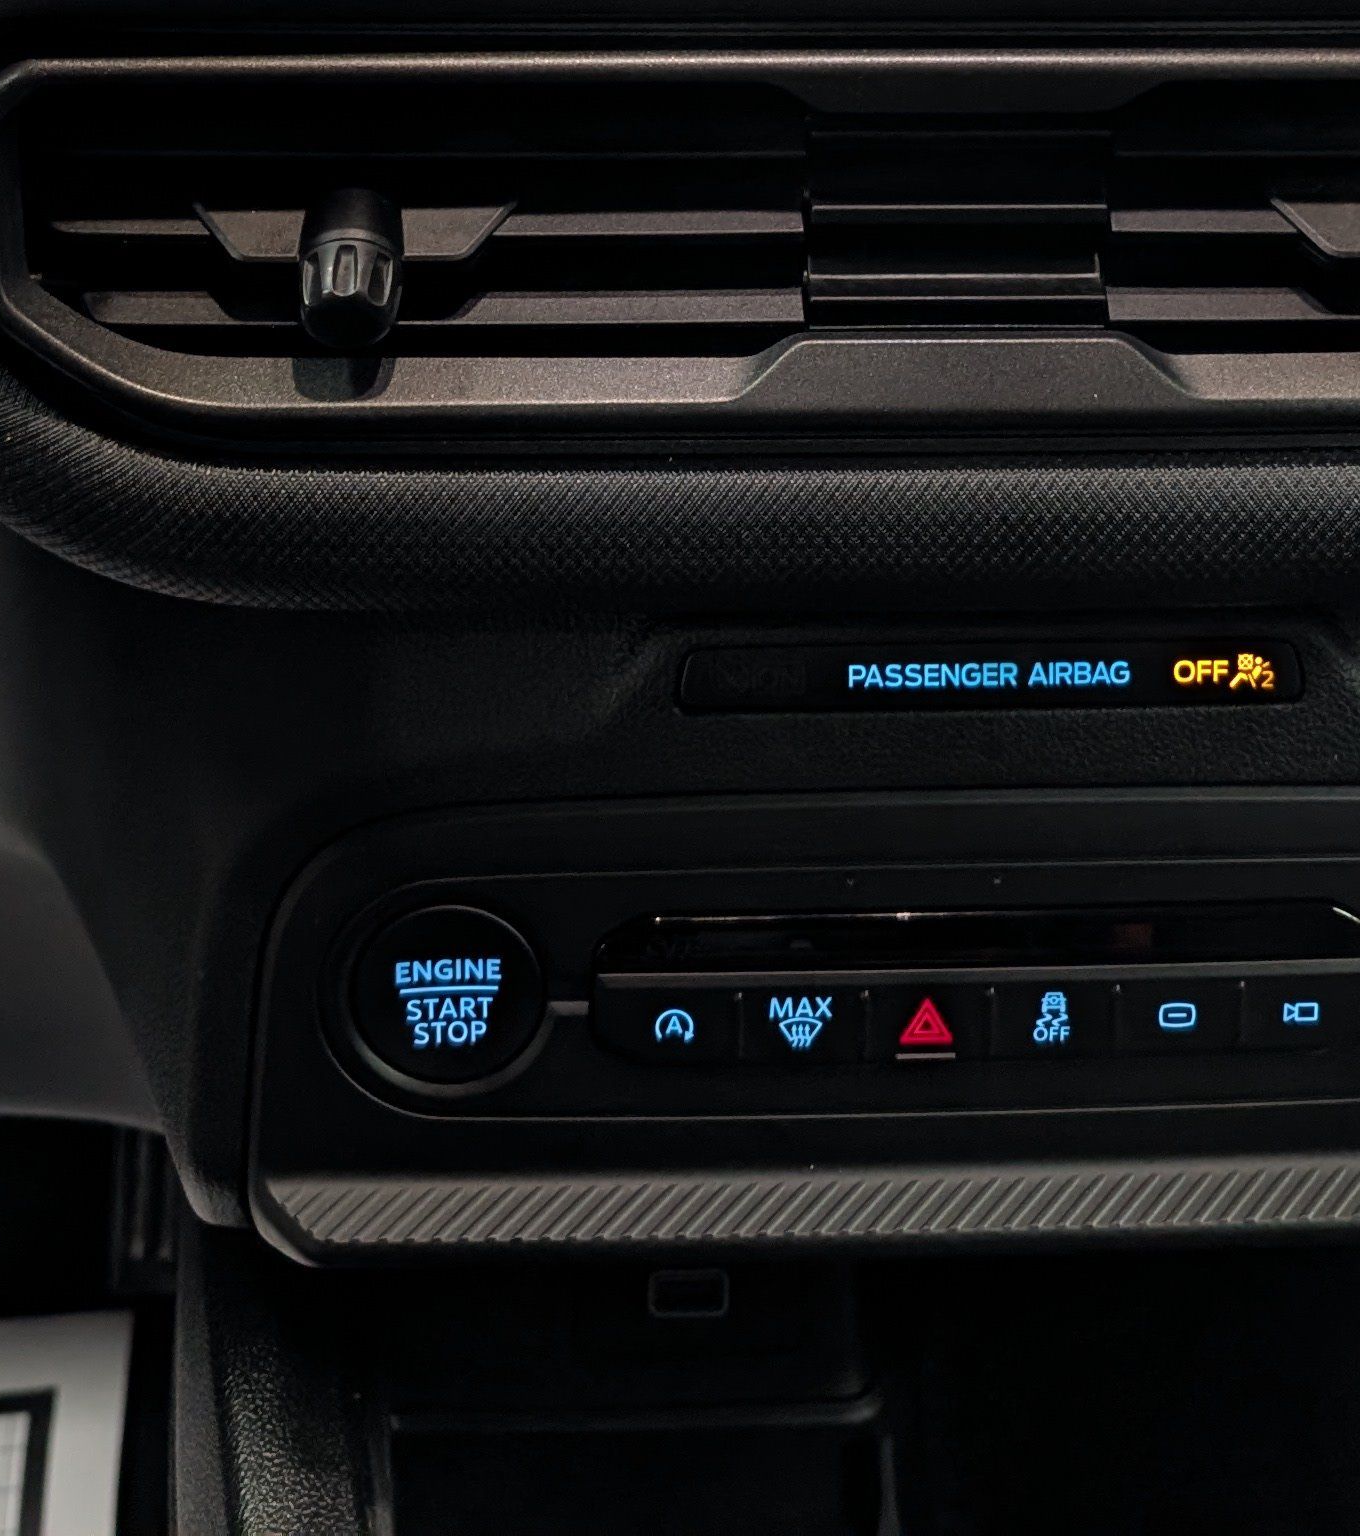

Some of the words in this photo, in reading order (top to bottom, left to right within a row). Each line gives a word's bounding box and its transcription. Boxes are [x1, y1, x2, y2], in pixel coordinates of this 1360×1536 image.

[847, 662, 1020, 690] PASSENGER
[1027, 660, 1132, 687] AIRBAG
[1172, 659, 1230, 684] OFF
[395, 958, 503, 985] ENGINE
[405, 997, 494, 1021] START
[769, 996, 833, 1019] MAX
[413, 1022, 488, 1047] STOP
[1033, 1025, 1071, 1043] OFF
